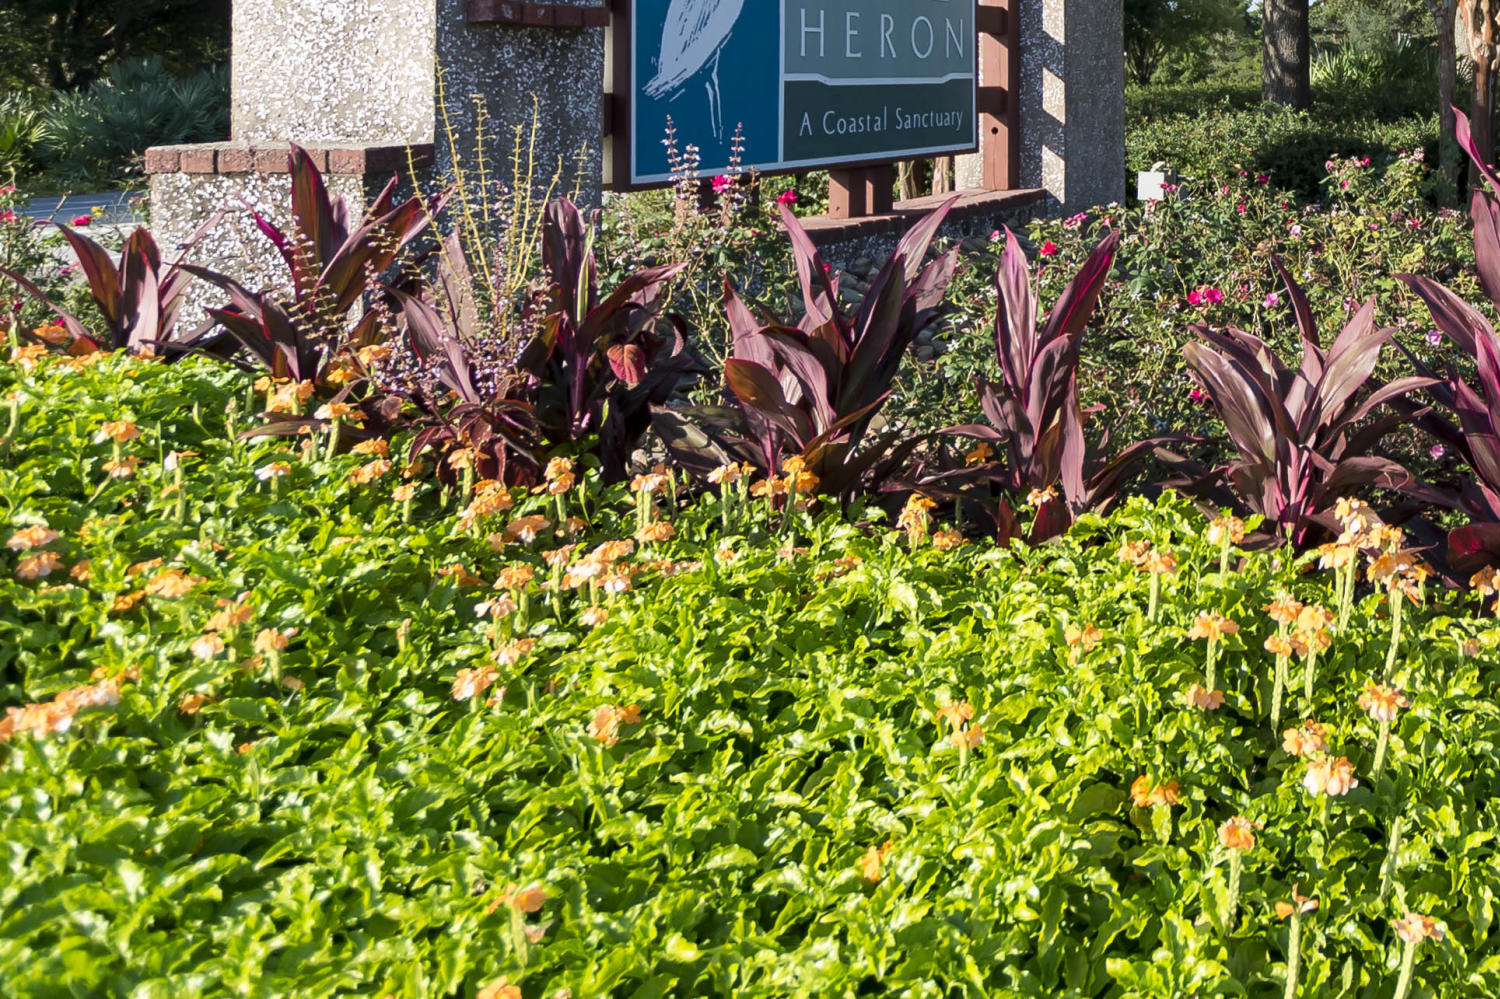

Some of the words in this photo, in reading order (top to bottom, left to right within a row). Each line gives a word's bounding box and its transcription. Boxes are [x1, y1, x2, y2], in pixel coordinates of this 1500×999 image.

[799, 7, 964, 60] HERON
[800, 111, 813, 137] A
[822, 106, 888, 136] Coastal
[895, 107, 964, 132] Sanctuary
